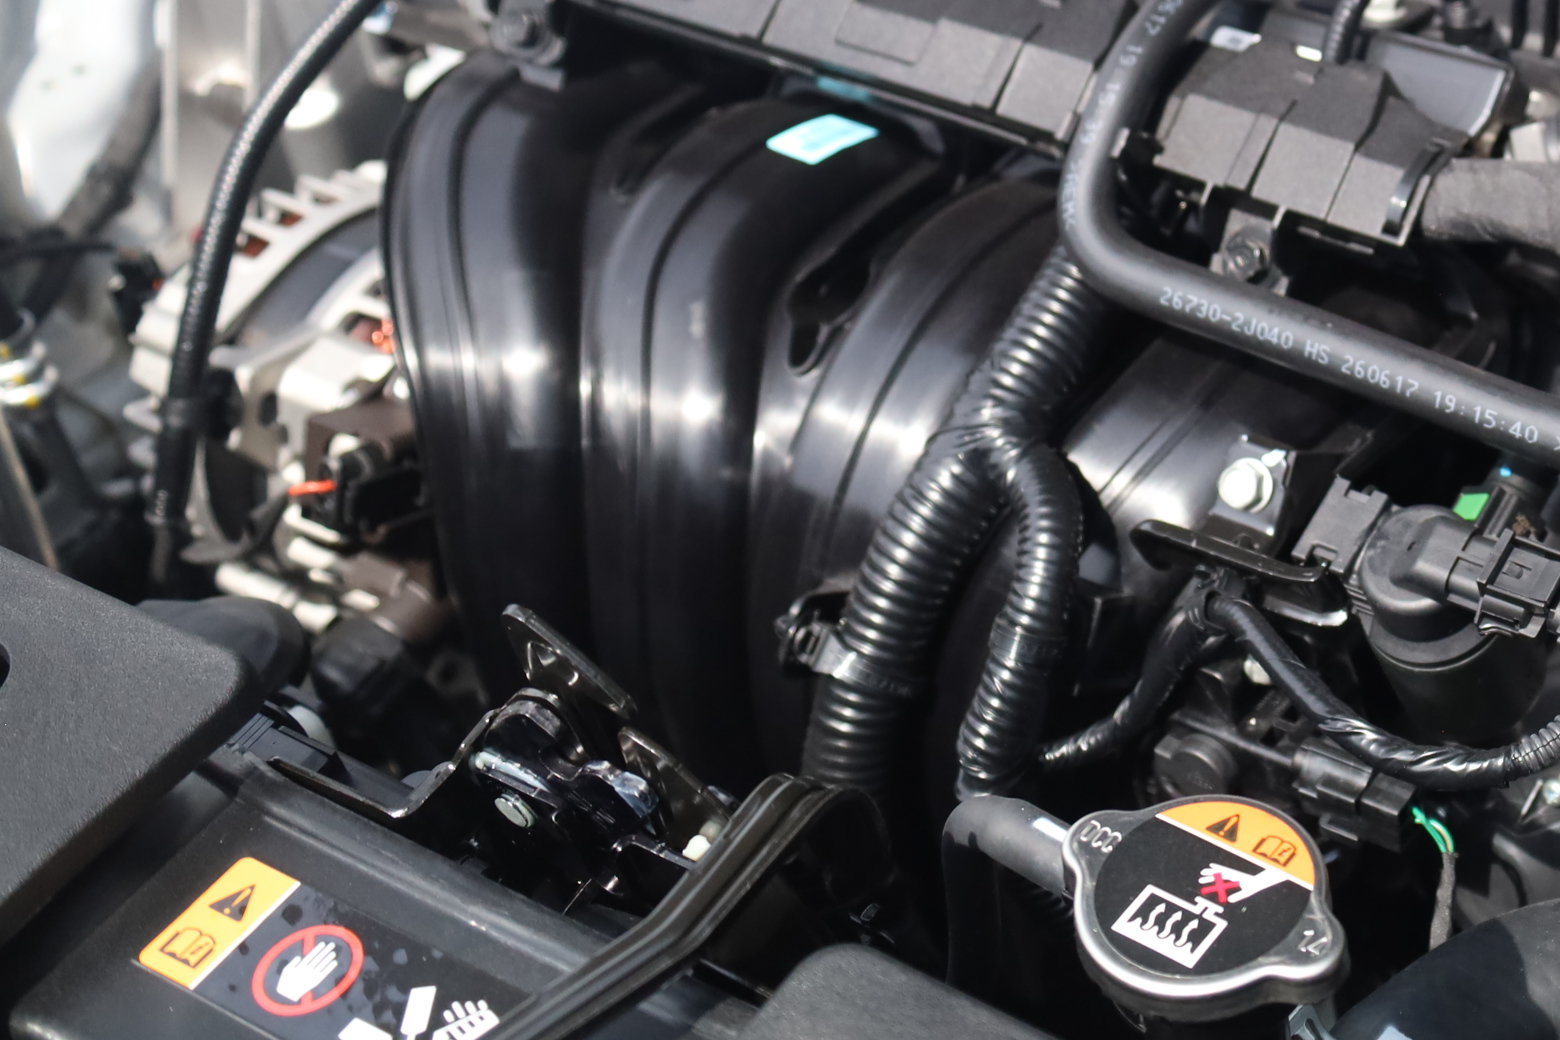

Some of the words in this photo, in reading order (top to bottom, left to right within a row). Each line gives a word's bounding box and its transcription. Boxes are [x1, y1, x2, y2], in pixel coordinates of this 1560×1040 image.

[1159, 287, 1294, 350] 26730-2J040
[1304, 339, 1331, 365] HS
[1341, 356, 1419, 398] 260617
[1433, 390, 1539, 445] 19:15:40
